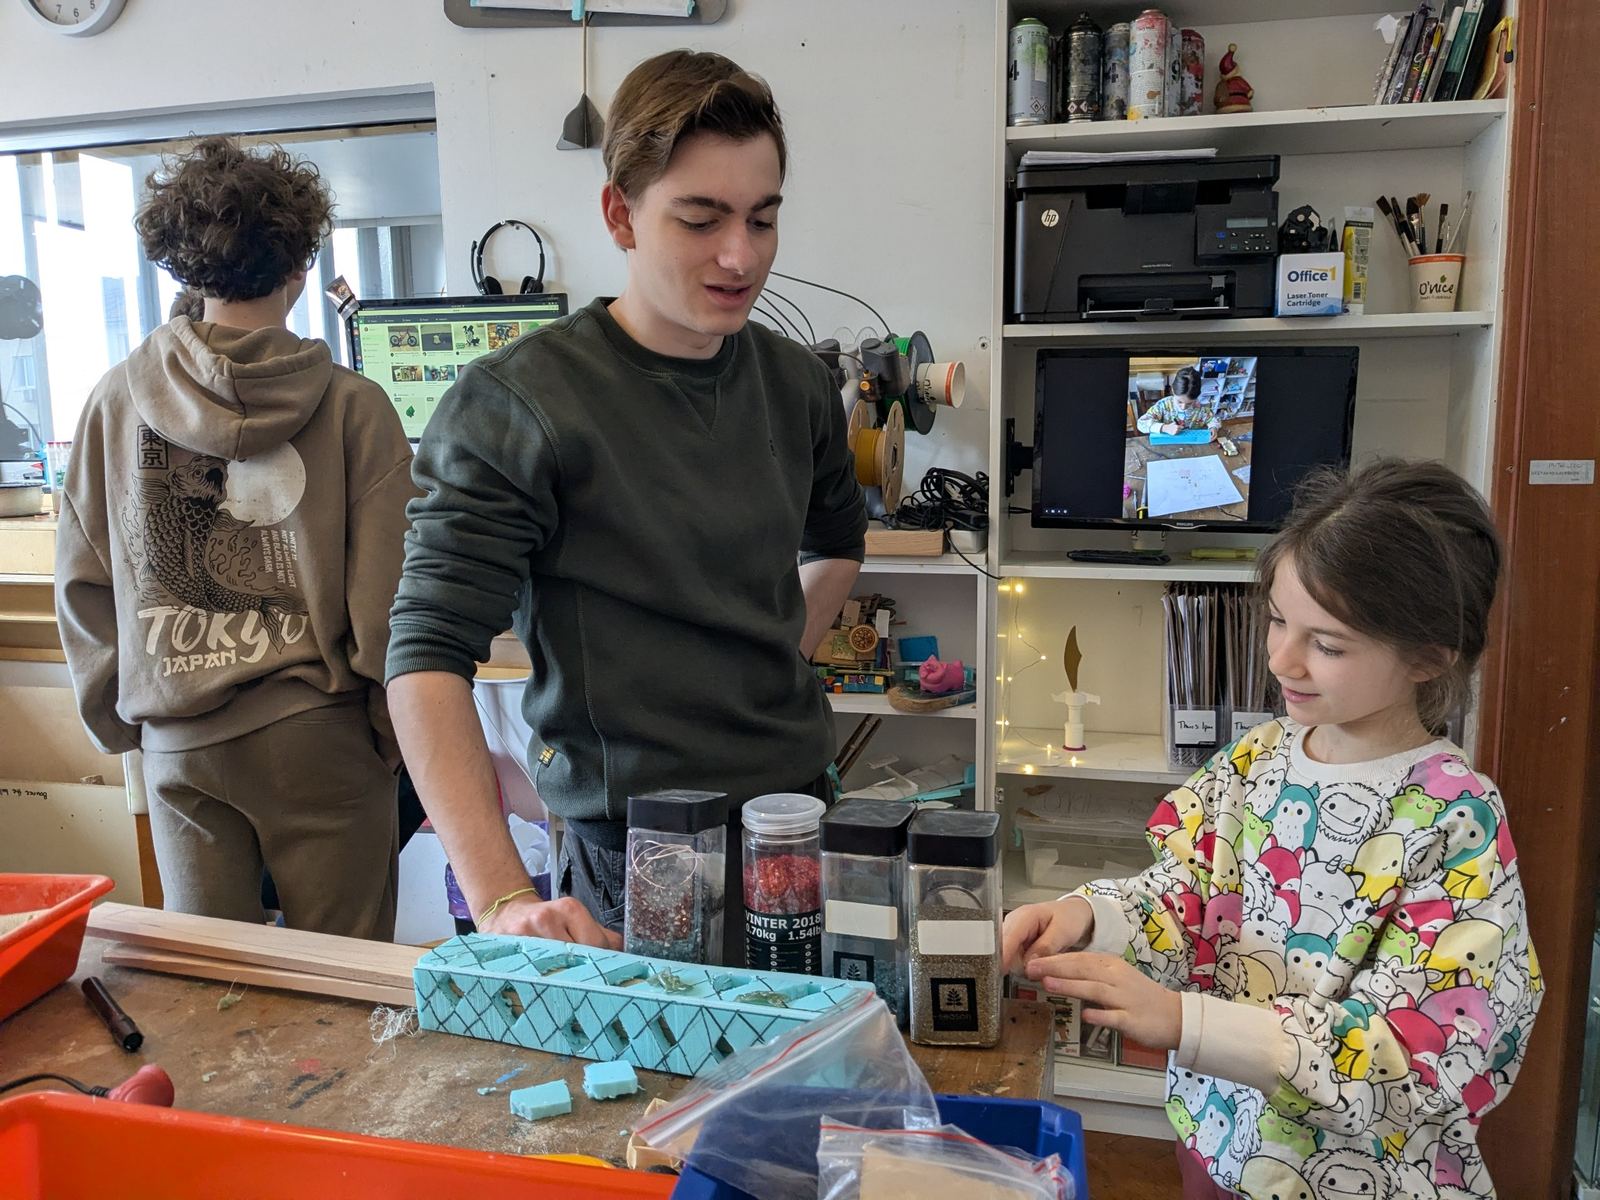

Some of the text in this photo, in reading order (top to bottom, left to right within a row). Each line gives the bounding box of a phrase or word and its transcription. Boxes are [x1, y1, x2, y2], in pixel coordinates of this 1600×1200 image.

[56, 4, 62, 14] 7
[73, 8, 80, 18] 6
[90, 0, 96, 10] 5
[1043, 209, 1058, 227] hp
[1419, 280, 1454, 296] O'nice
[1286, 299, 1321, 307] Cartridge
[140, 428, 164, 466] 東京
[137, 605, 308, 664] TOKYO
[162, 649, 237, 678] JAPAN
[792, 913, 821, 929] 2018
[745, 922, 777, 942] 0.70kg
